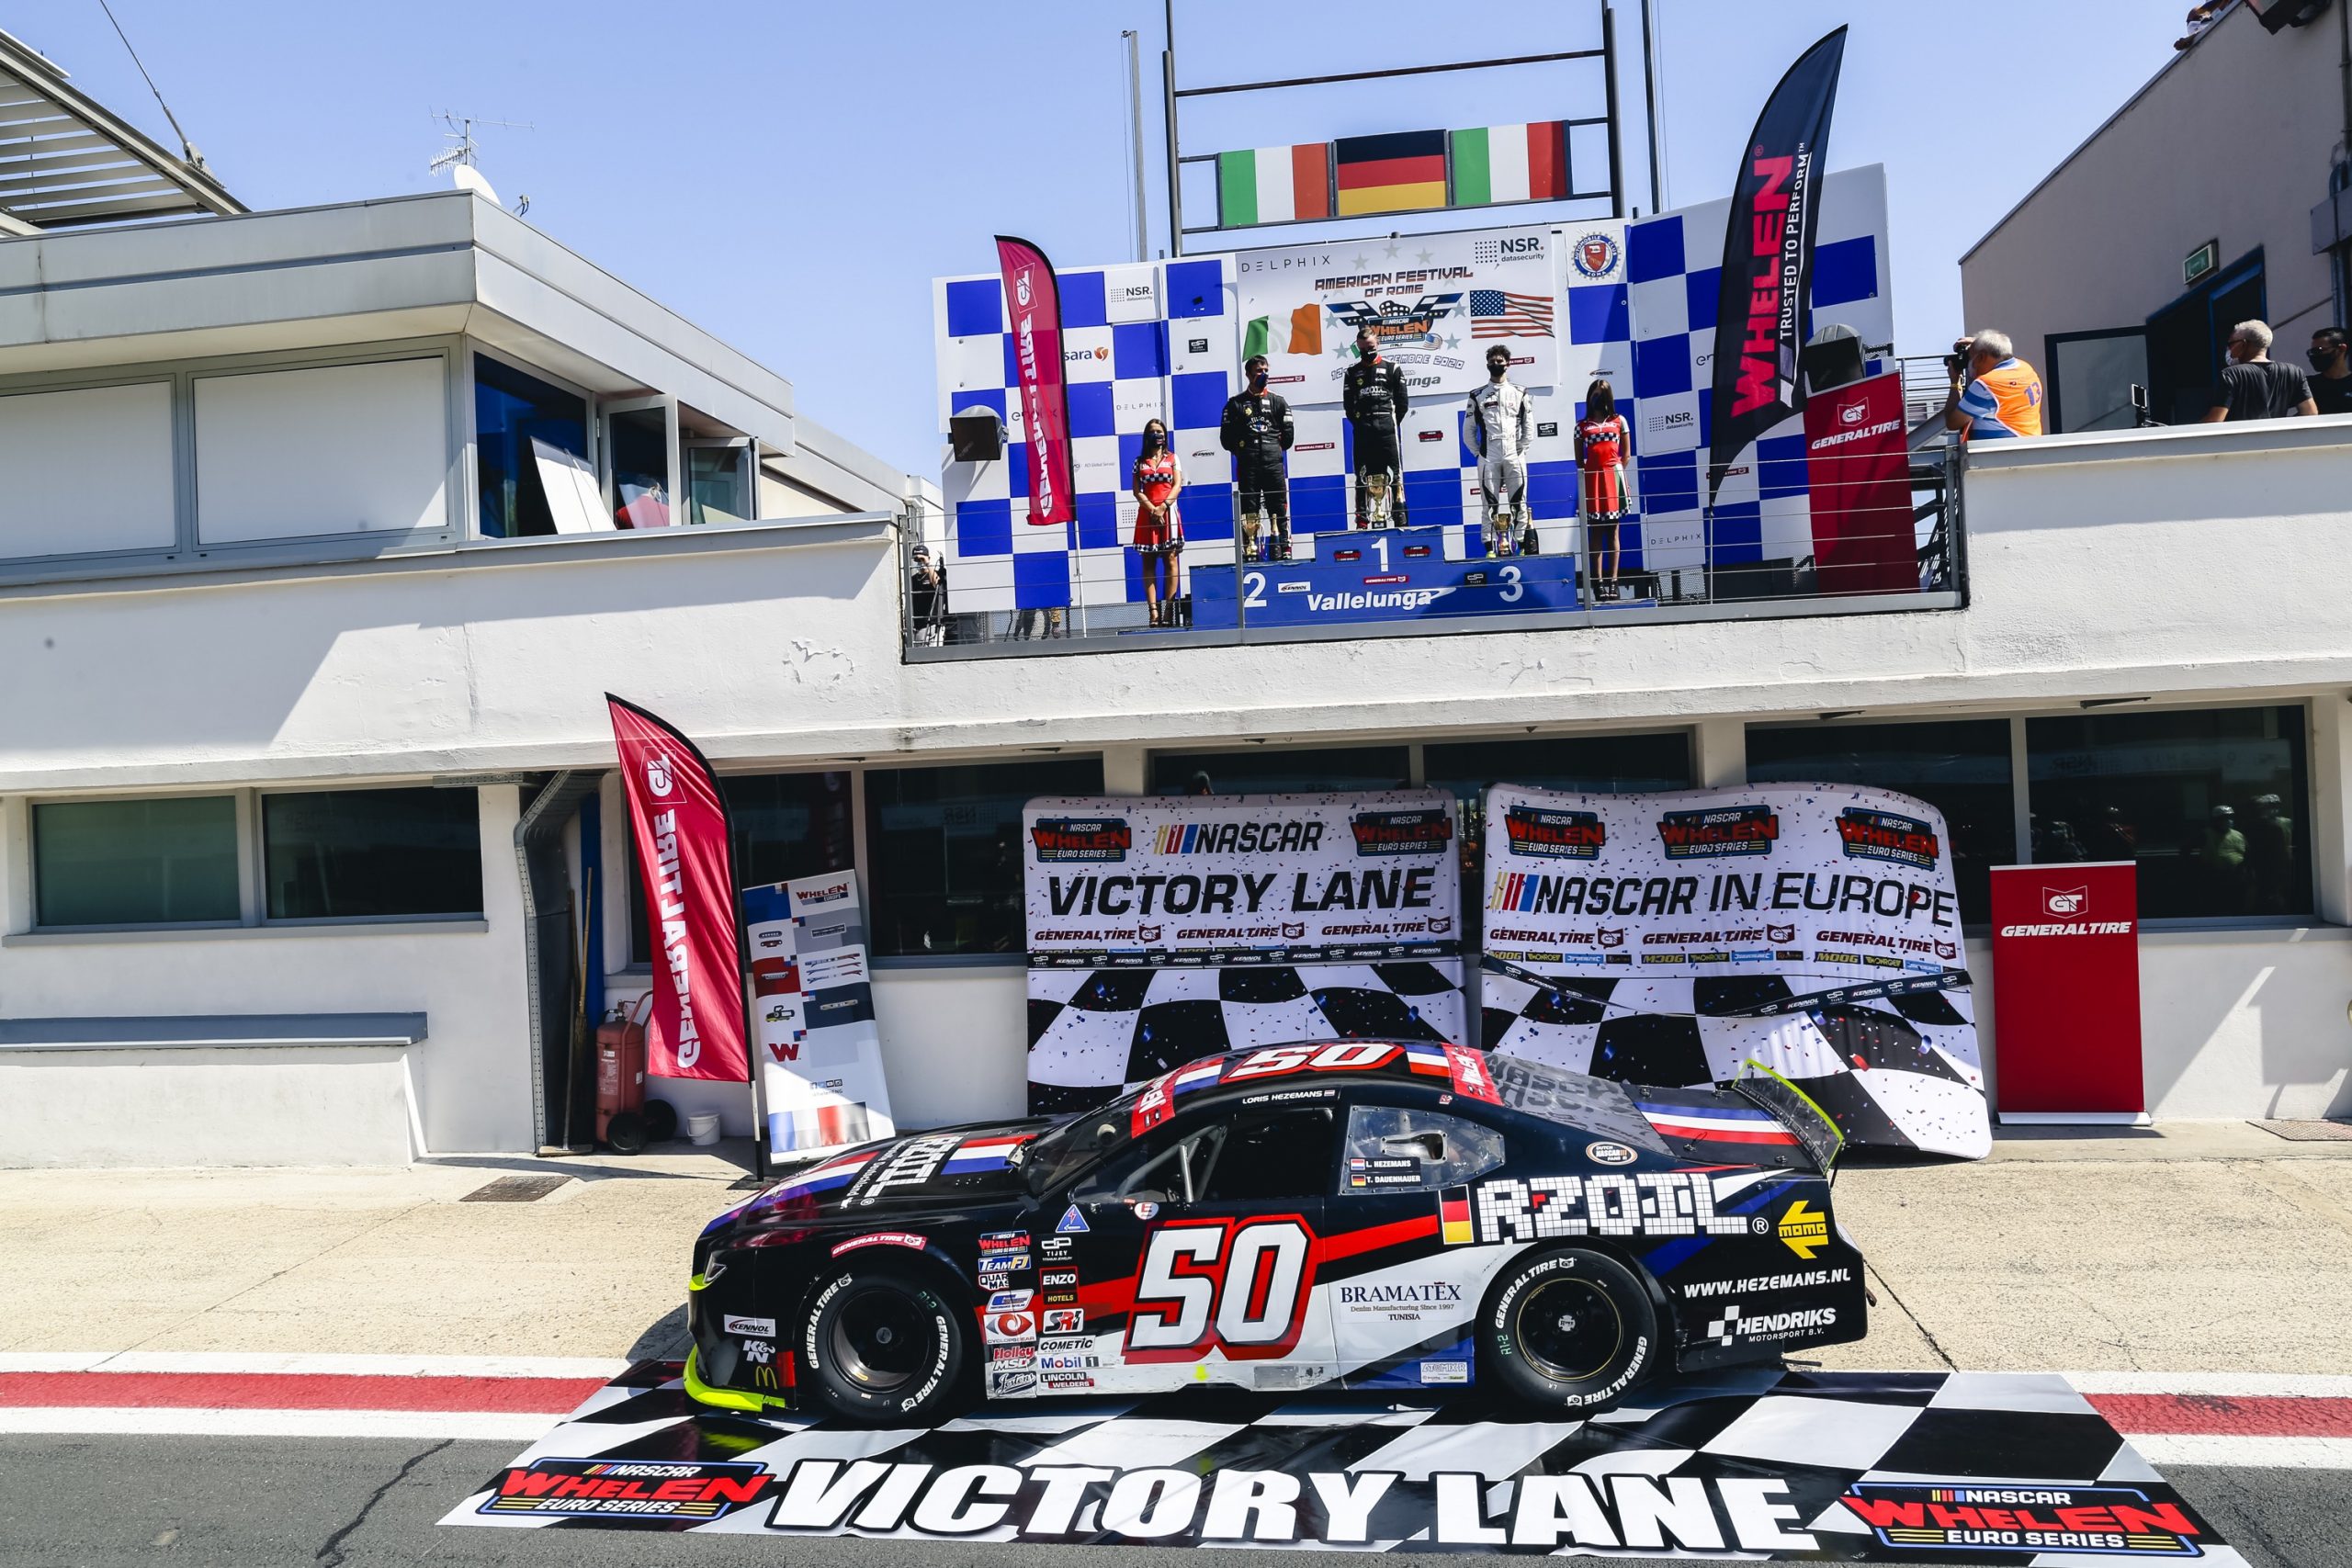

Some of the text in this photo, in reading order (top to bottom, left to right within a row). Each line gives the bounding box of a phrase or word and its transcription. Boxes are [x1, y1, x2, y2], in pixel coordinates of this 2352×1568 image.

[1574, 235, 1617, 261] AUTOMOBILE CLUB
[1785, 239, 1798, 262] TO
[1242, 254, 1331, 273] DELPHIX
[1501, 253, 1544, 264] datasecurity
[1315, 266, 1474, 291] AMERICAN FESTIVAL
[1364, 284, 1424, 298] OF ROME
[1780, 266, 1799, 340] TRUSTED
[1433, 355, 1464, 369] 2020
[2024, 381, 2042, 407] 13
[1116, 401, 1165, 411] DELPHIX
[1666, 422, 1694, 430] datasecurity
[1651, 533, 1702, 546] DELPHIX
[1371, 536, 1389, 572] 1
[1243, 571, 1267, 608] 2
[1499, 565, 1523, 603] 3
[1307, 590, 1432, 612] Vallelunga
[1390, 815, 1422, 825] NASCAR
[1540, 815, 1572, 826] NASCAR
[1704, 812, 1741, 824] NASCAR
[1881, 817, 1913, 832] NASCAR
[1069, 823, 1102, 832] NASCAR
[1352, 819, 1453, 842] WHELEN
[1507, 818, 1605, 844] WHELEN
[1658, 817, 1778, 845] WHELEN
[1033, 828, 1131, 849] WHELEN
[1194, 821, 1324, 854] NASCAR
[1837, 819, 1939, 859] WHELEN
[1057, 850, 1107, 858] EURO SERIES
[1378, 841, 1428, 852] EURO SERIES
[1528, 842, 1577, 854] EURO SERIES
[1689, 841, 1748, 854] EURO SERIES
[1867, 845, 1918, 862] EURO SERIES
[797, 883, 848, 900] WHELEN
[1049, 867, 1436, 916] VICTORY LANE
[1534, 872, 1955, 928] NASCAR IN EUROPE
[1817, 953, 1859, 963] MOOG
[1912, 979, 1938, 988] KENNOL
[1852, 987, 1883, 997] KENNOL
[1787, 998, 1819, 1009] KENNOL
[1223, 1043, 1400, 1080] 50
[1242, 1089, 1323, 1104] LORIS HEZEMANS
[1596, 1149, 1621, 1157] NASCAR
[1374, 1159, 1411, 1168] HEZEMANS
[1374, 1175, 1421, 1183] DAUENHAUER
[978, 1235, 1031, 1249] WHELEN
[1043, 1273, 1077, 1286] ENZO
[1129, 1222, 1310, 1349] 50
[1684, 1269, 1851, 1299] WWW.HEZEMANS.NL
[1047, 1294, 1074, 1303] HOTELS
[1340, 1283, 1462, 1303] BRAMATEX
[1373, 1304, 1419, 1313] Manufacturing
[732, 1323, 769, 1333] KENNOL
[1736, 1307, 1837, 1335] HENDRIKS
[1748, 1327, 1825, 1343] MOTORSPORT B.V.
[1041, 1338, 1092, 1350] COMETIC
[994, 1346, 1035, 1359] Holley
[1041, 1357, 1081, 1369] Mobil
[1042, 1372, 1085, 1382] LINCOLN
[611, 1464, 703, 1478] NASCAR
[499, 1469, 775, 1503] WHELEN
[772, 1460, 1820, 1551] VICTORY LANE
[1964, 1490, 2073, 1506] NASCAR
[534, 1498, 682, 1514] EURO SERIES
[1839, 1495, 2200, 1536] WHELEN
[1947, 1529, 2124, 1548] EURO SERIES
